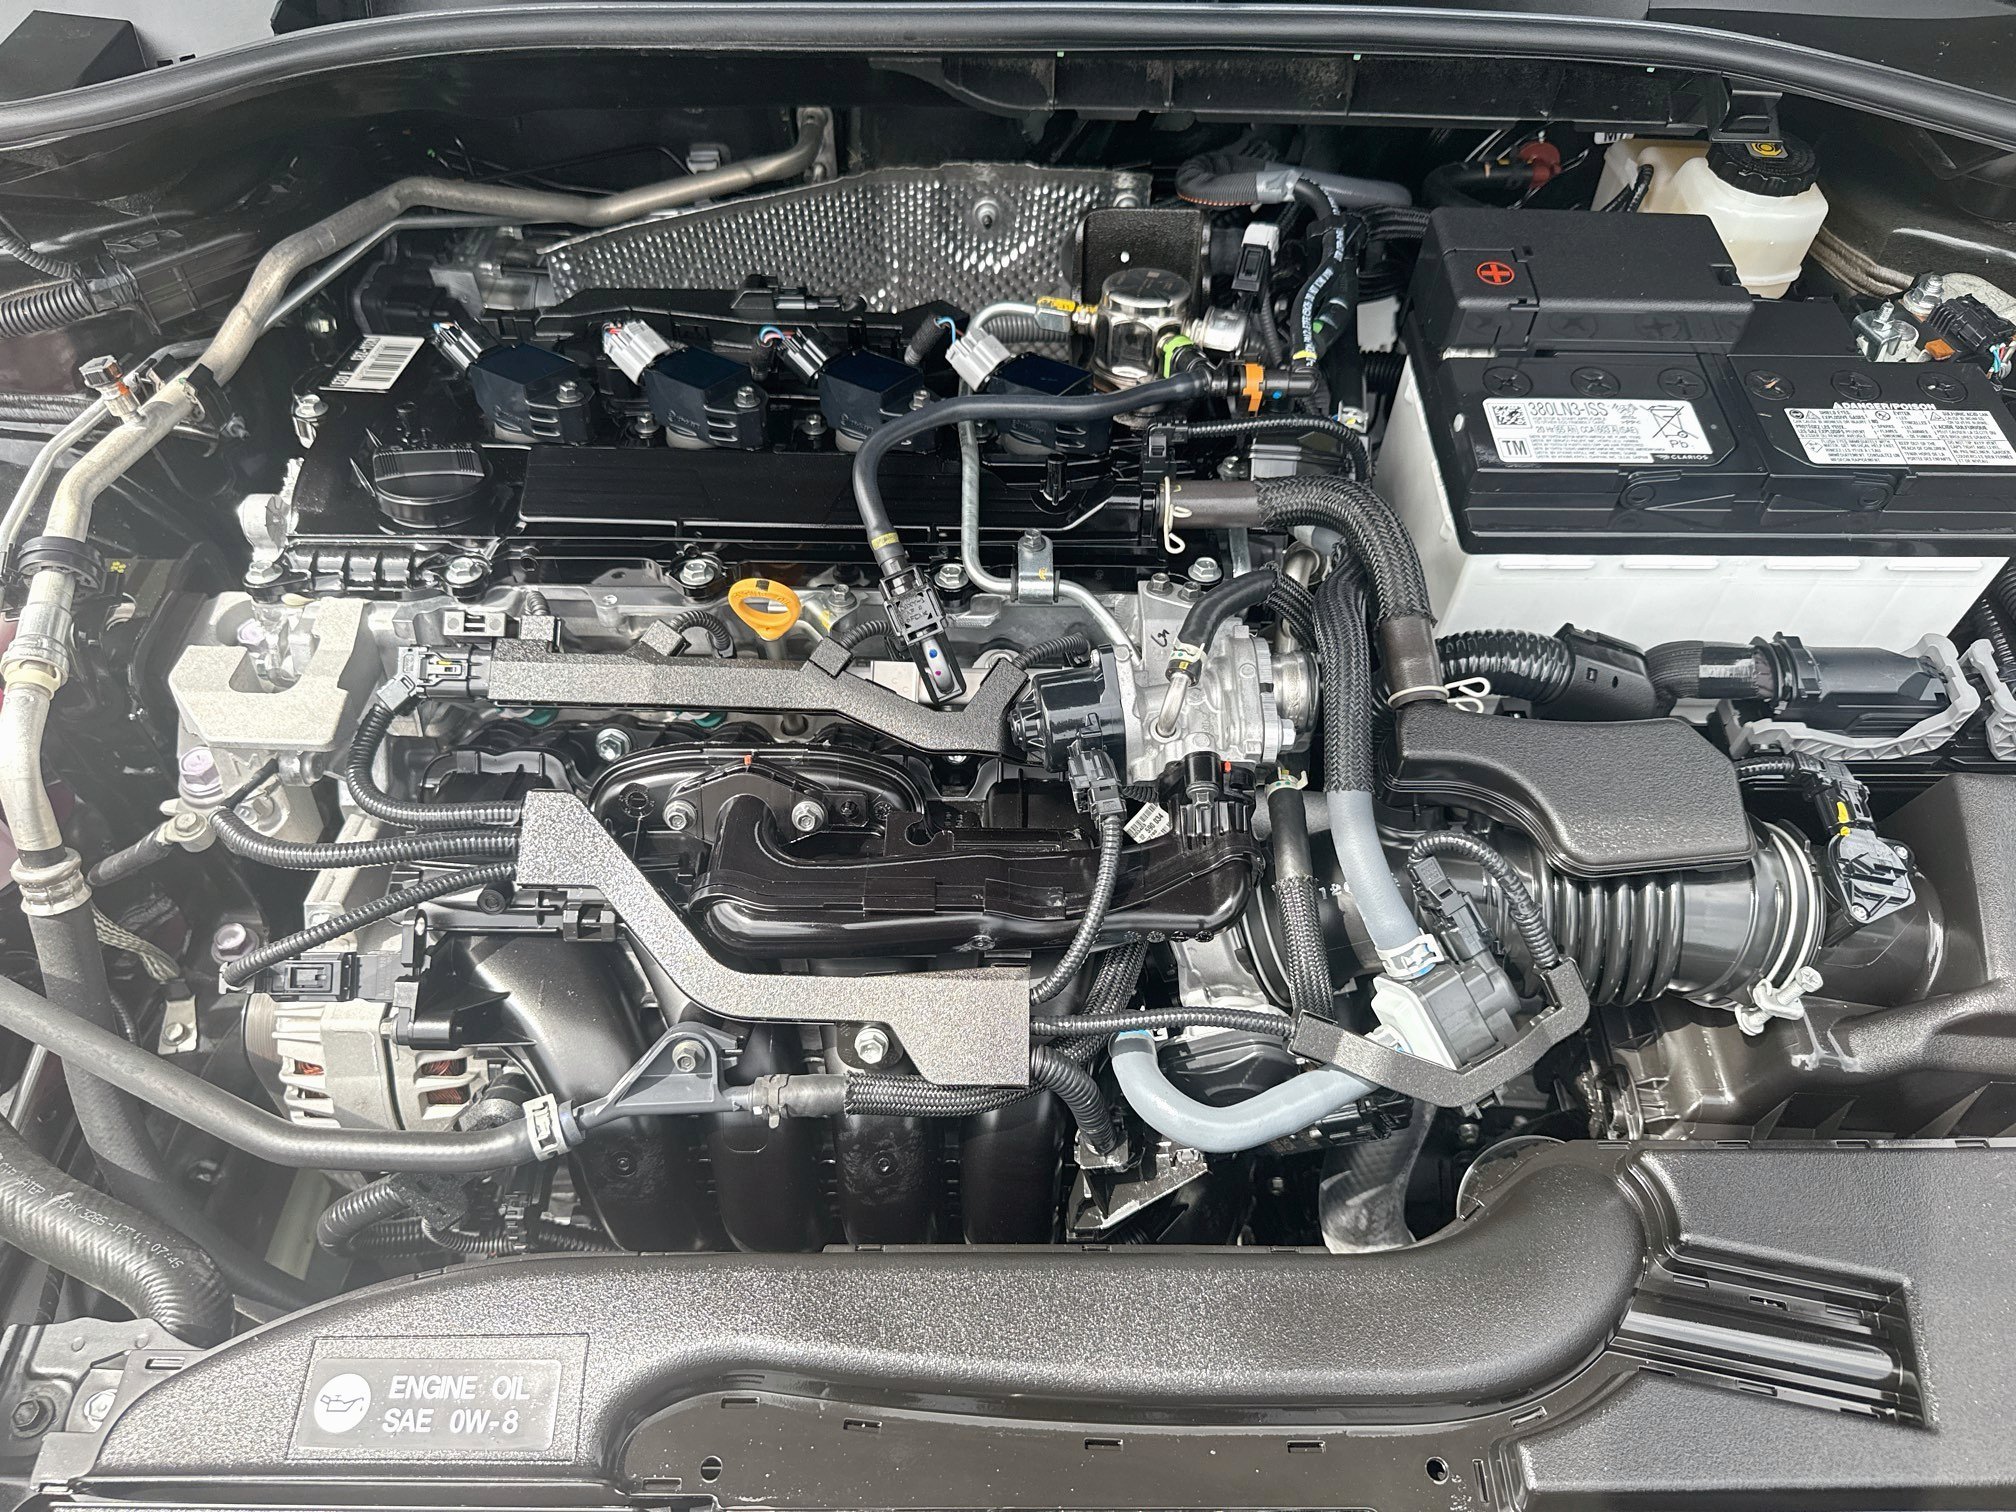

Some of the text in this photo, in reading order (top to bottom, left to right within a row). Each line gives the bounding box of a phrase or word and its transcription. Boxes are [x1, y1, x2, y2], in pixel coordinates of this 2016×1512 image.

[1527, 401, 1608, 416] 380LN3-ISS
[1841, 402, 1938, 410] DANGER/POISON
[1501, 440, 1528, 456] TM
[388, 1374, 531, 1401] ENGINE OIL
[381, 1407, 520, 1434] SAE 0W-8
